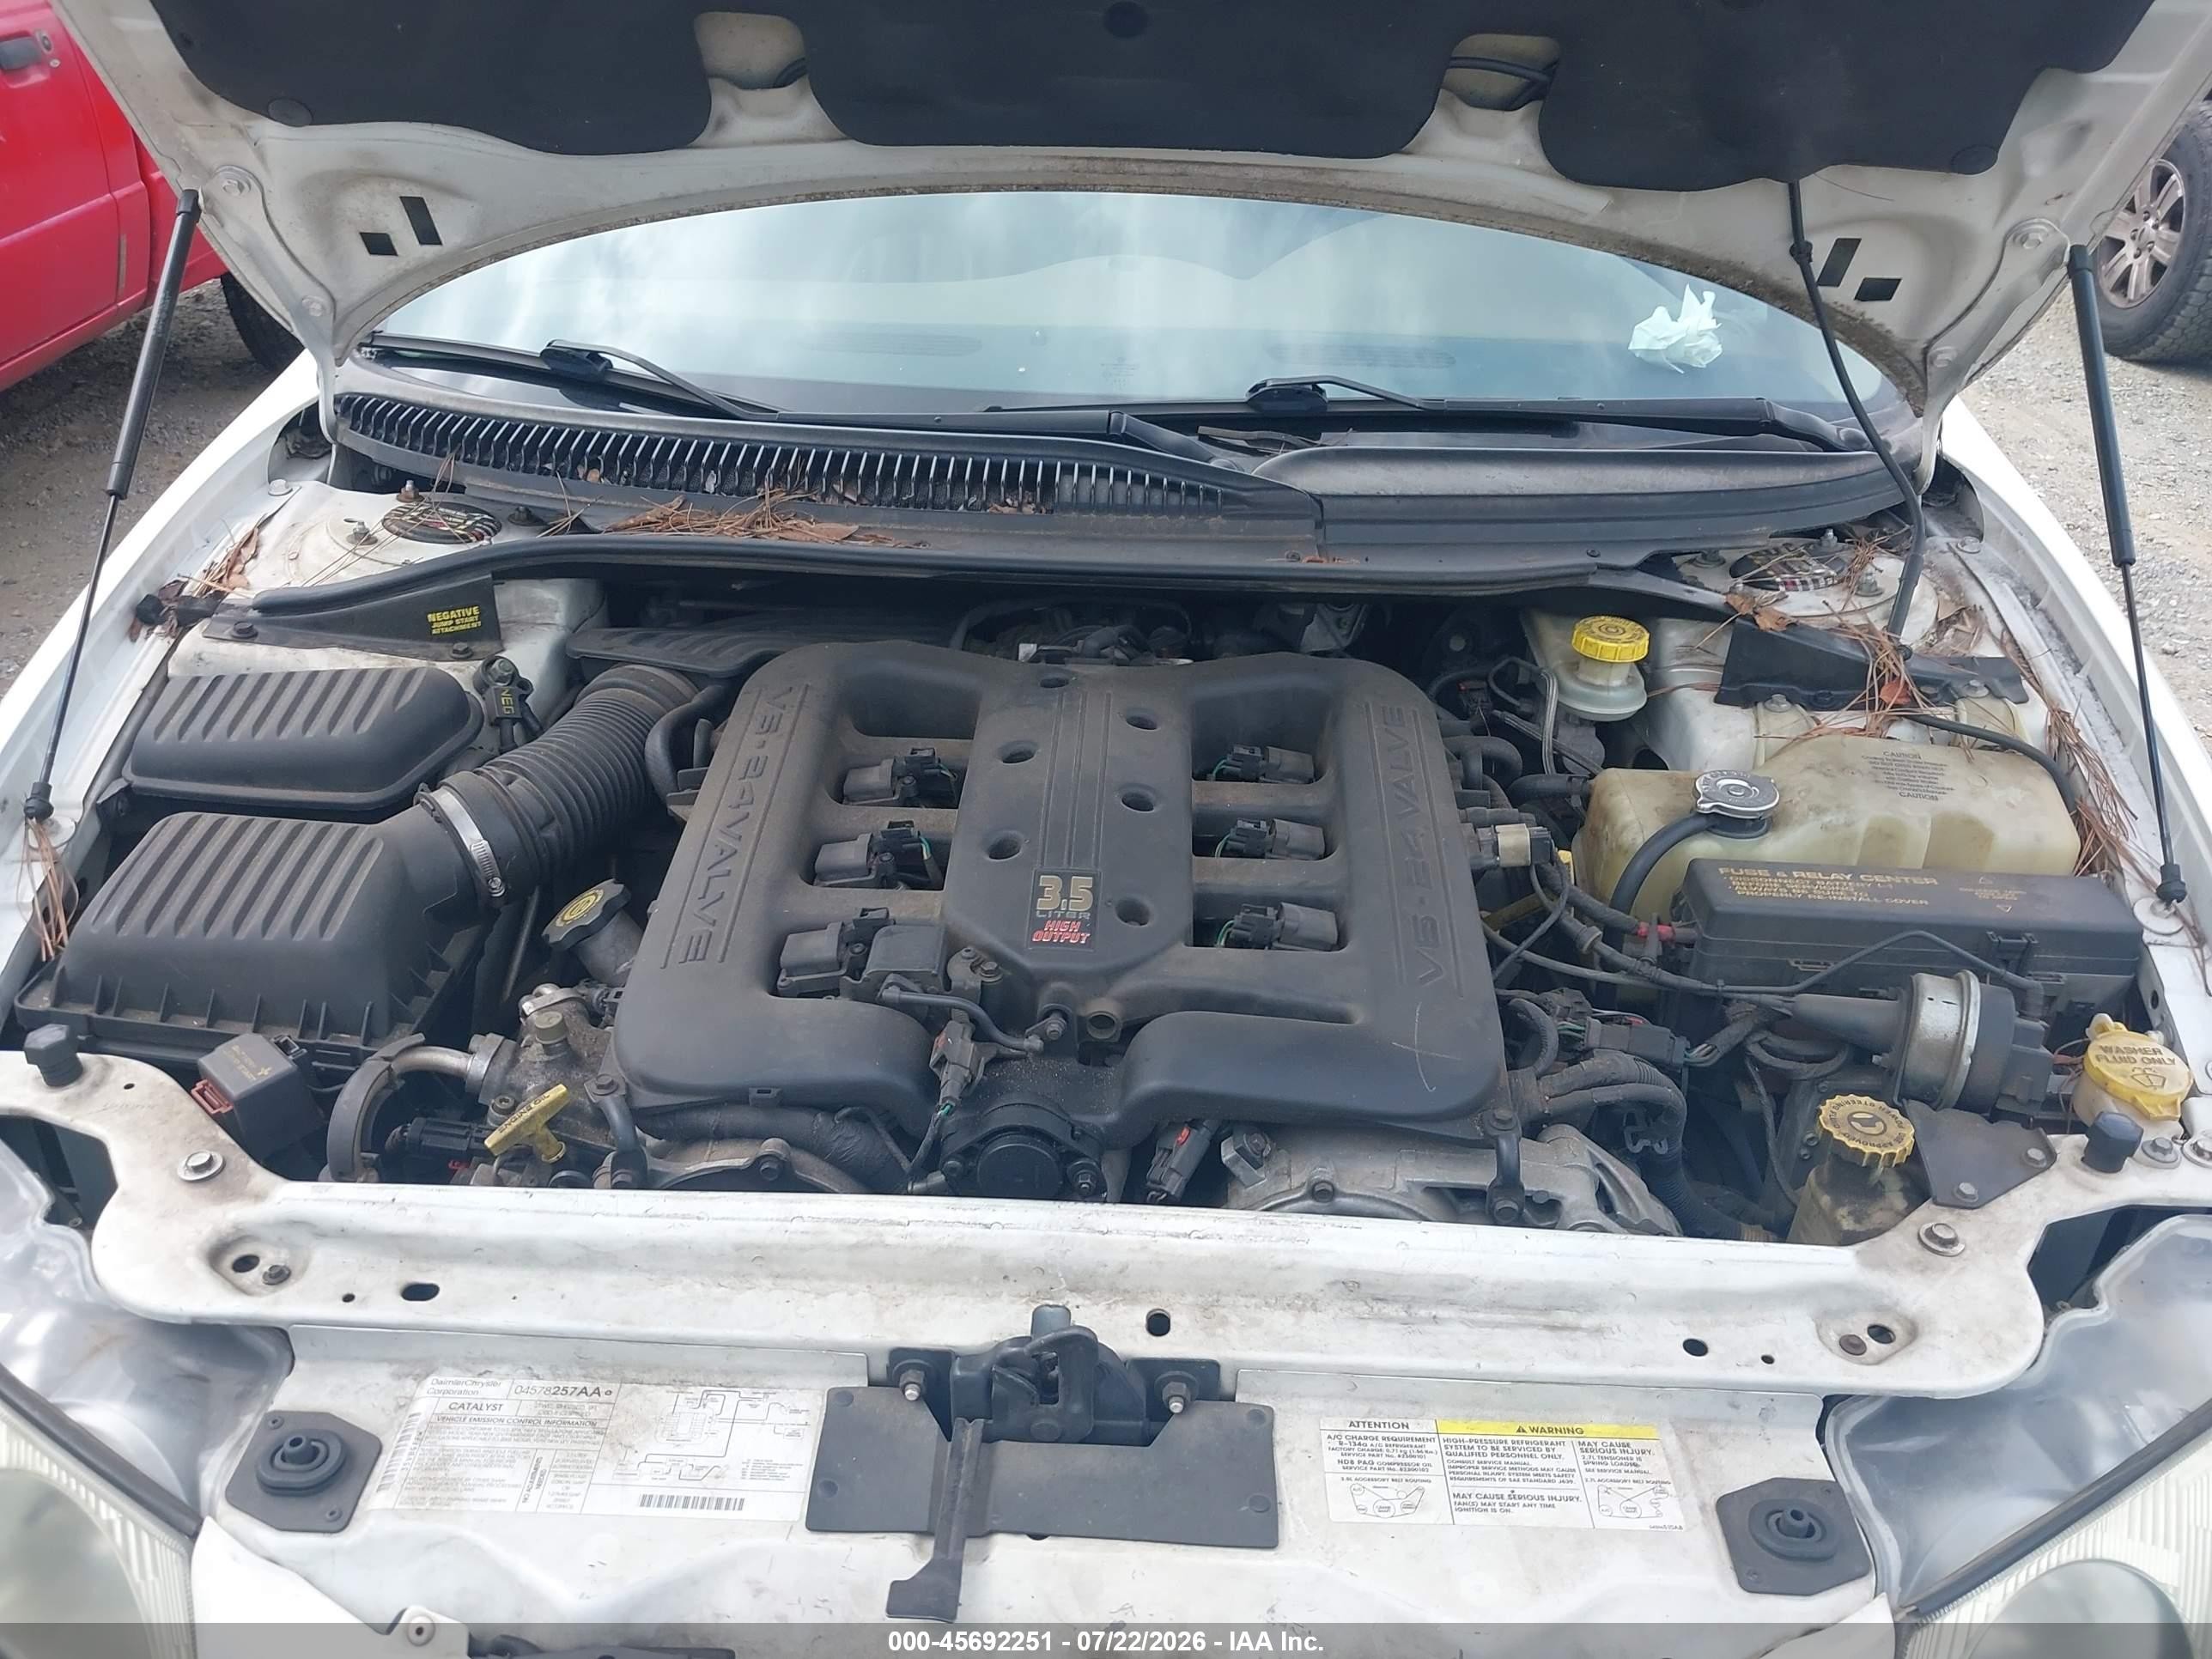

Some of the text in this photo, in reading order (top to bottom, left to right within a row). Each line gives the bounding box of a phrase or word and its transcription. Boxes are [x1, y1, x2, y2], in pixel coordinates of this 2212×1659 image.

[428, 606, 480, 622] NEGATIVE
[501, 689, 515, 714] NEG
[1883, 750, 1922, 760] CAUTION
[1899, 791, 1939, 801] CAUTION
[1718, 867, 1770, 877] FUSE
[1792, 871, 1853, 880] RELAY
[1859, 874, 1938, 885] CENTER
[1036, 875, 1094, 911] 3.5
[1036, 910, 1091, 920] LITER
[1044, 920, 1081, 933] HIGH
[1032, 929, 1091, 944] OUTPUT
[2100, 1045, 2163, 1055] WASHER
[2095, 1054, 2176, 1065] FLUID ONLY
[498, 1094, 550, 1133] ENGINE OIL
[431, 1377, 501, 1388] DaimlerChrysler
[427, 1387, 479, 1396] Corporation
[514, 1385, 601, 1396] 04578257AA
[448, 1401, 504, 1411] CATALYST
[1348, 1420, 1410, 1430] ATTENTION
[1528, 1425, 1584, 1435] WARNING
